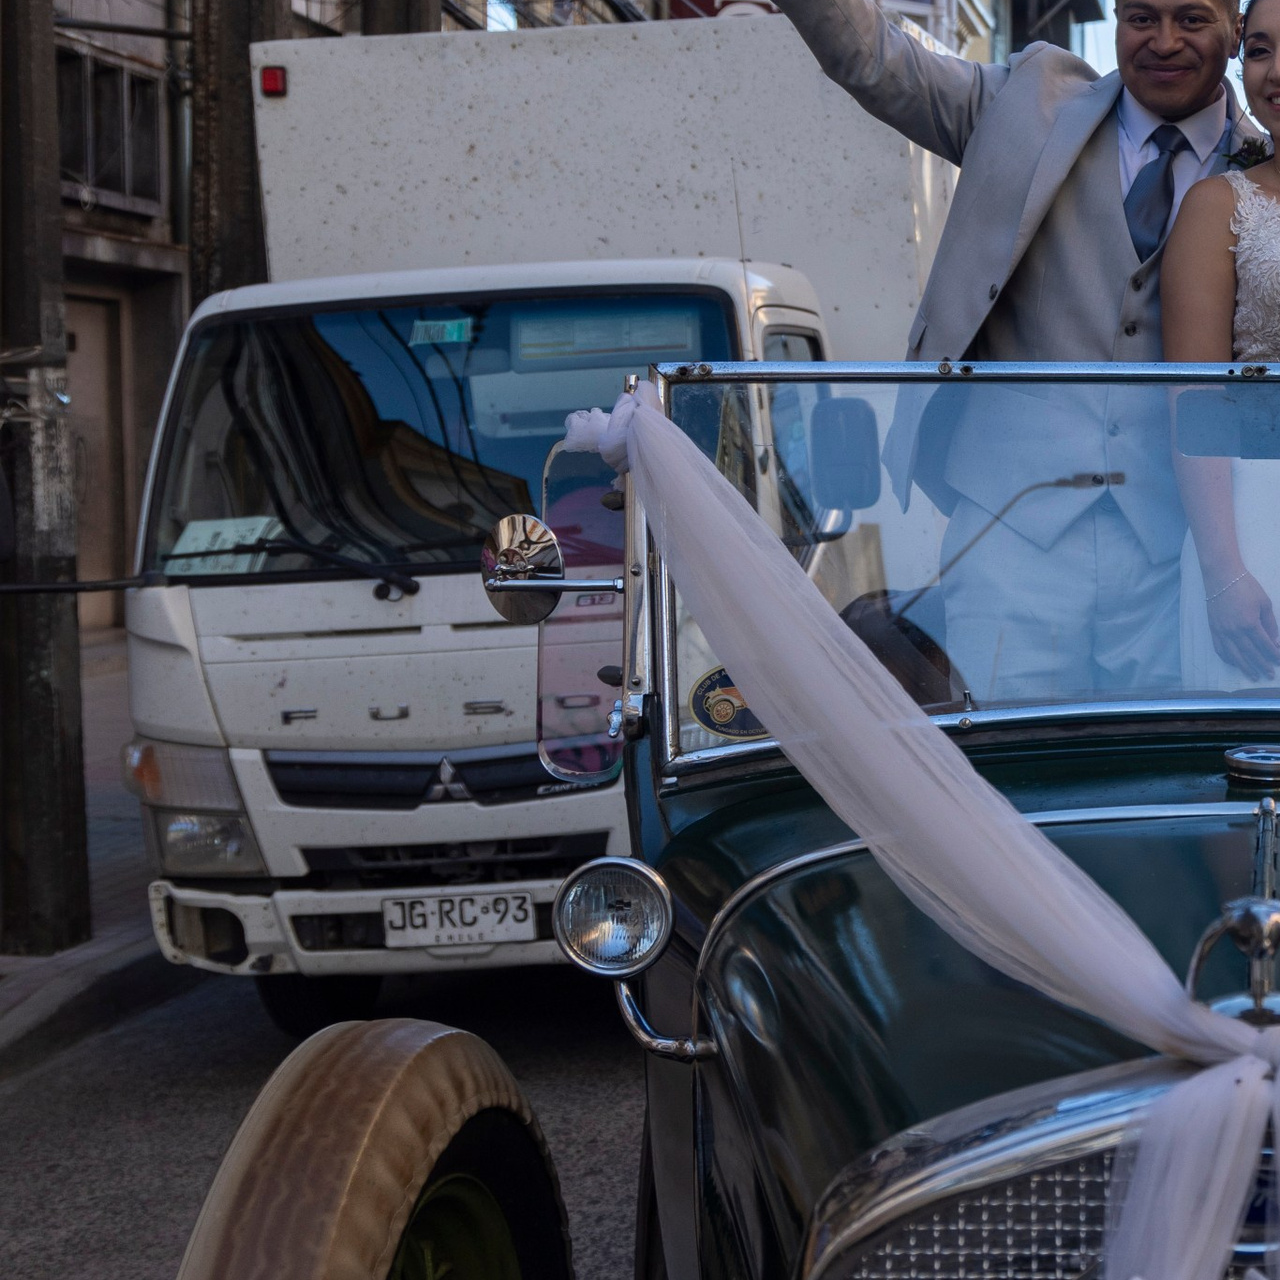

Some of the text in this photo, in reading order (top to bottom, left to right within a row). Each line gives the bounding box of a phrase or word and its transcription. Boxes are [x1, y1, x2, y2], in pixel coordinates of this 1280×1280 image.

[697, 678, 712, 695] CLUB
[711, 673, 720, 682] DE
[281, 694, 600, 725] FUSO
